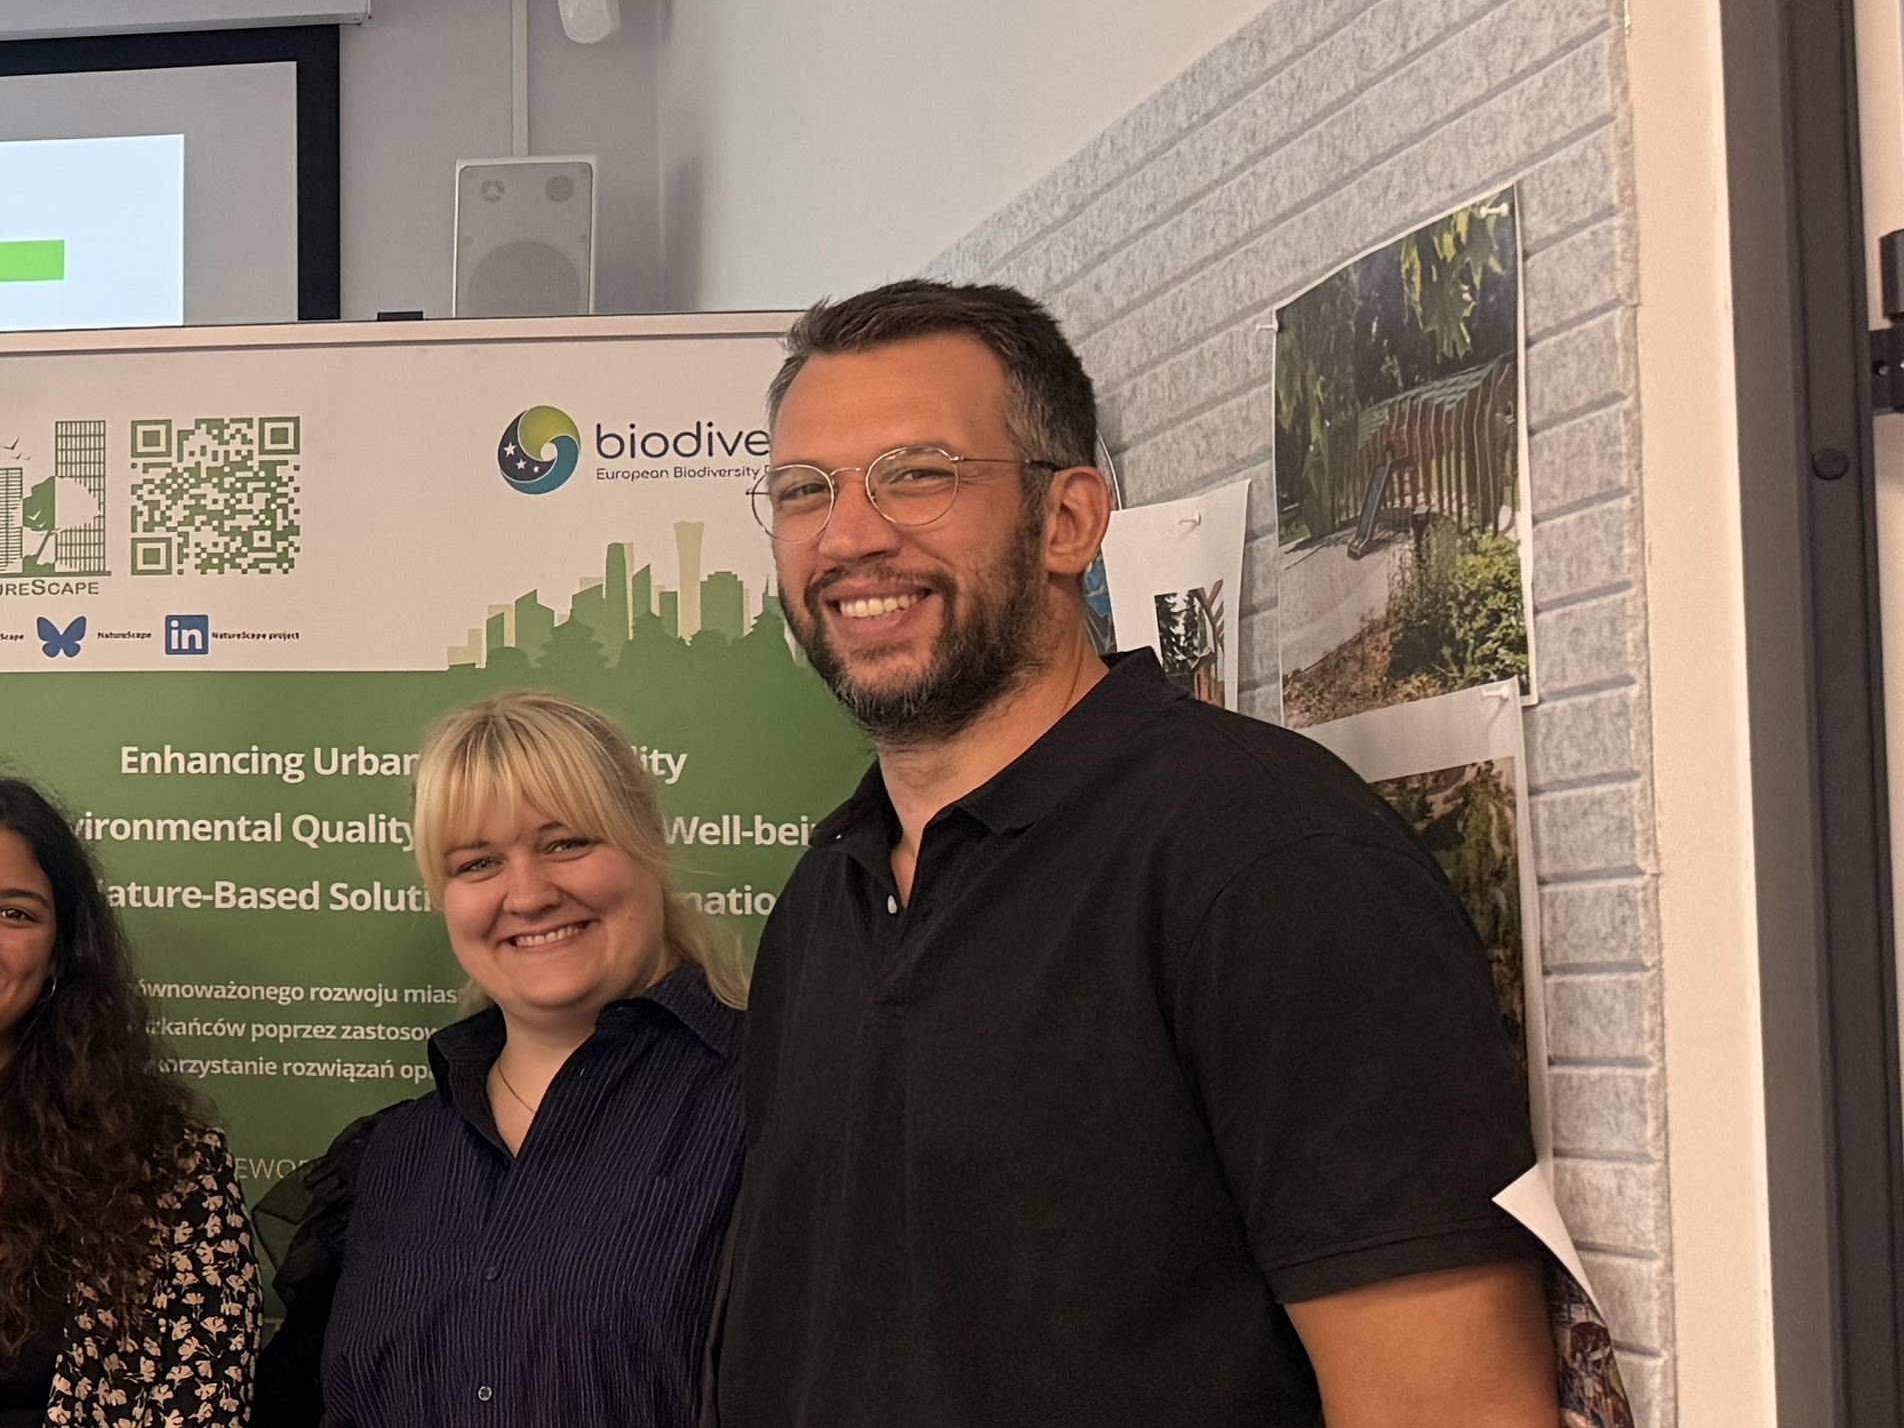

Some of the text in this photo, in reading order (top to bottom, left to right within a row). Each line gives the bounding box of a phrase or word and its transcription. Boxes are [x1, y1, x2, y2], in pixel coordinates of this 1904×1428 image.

[596, 467, 670, 482] European
[673, 464, 760, 480] Biodiversity
[97, 630, 152, 640] NatureScape
[211, 630, 301, 642] NatureScape project
[121, 745, 306, 784] Enhancing
[291, 813, 416, 853] Quality
[662, 813, 819, 846] Well-bei
[97, 879, 321, 911] ature-Based
[309, 983, 399, 1008] rozwoju
[250, 1023, 338, 1044] poprzez
[282, 1058, 395, 1084] rozwiązań
